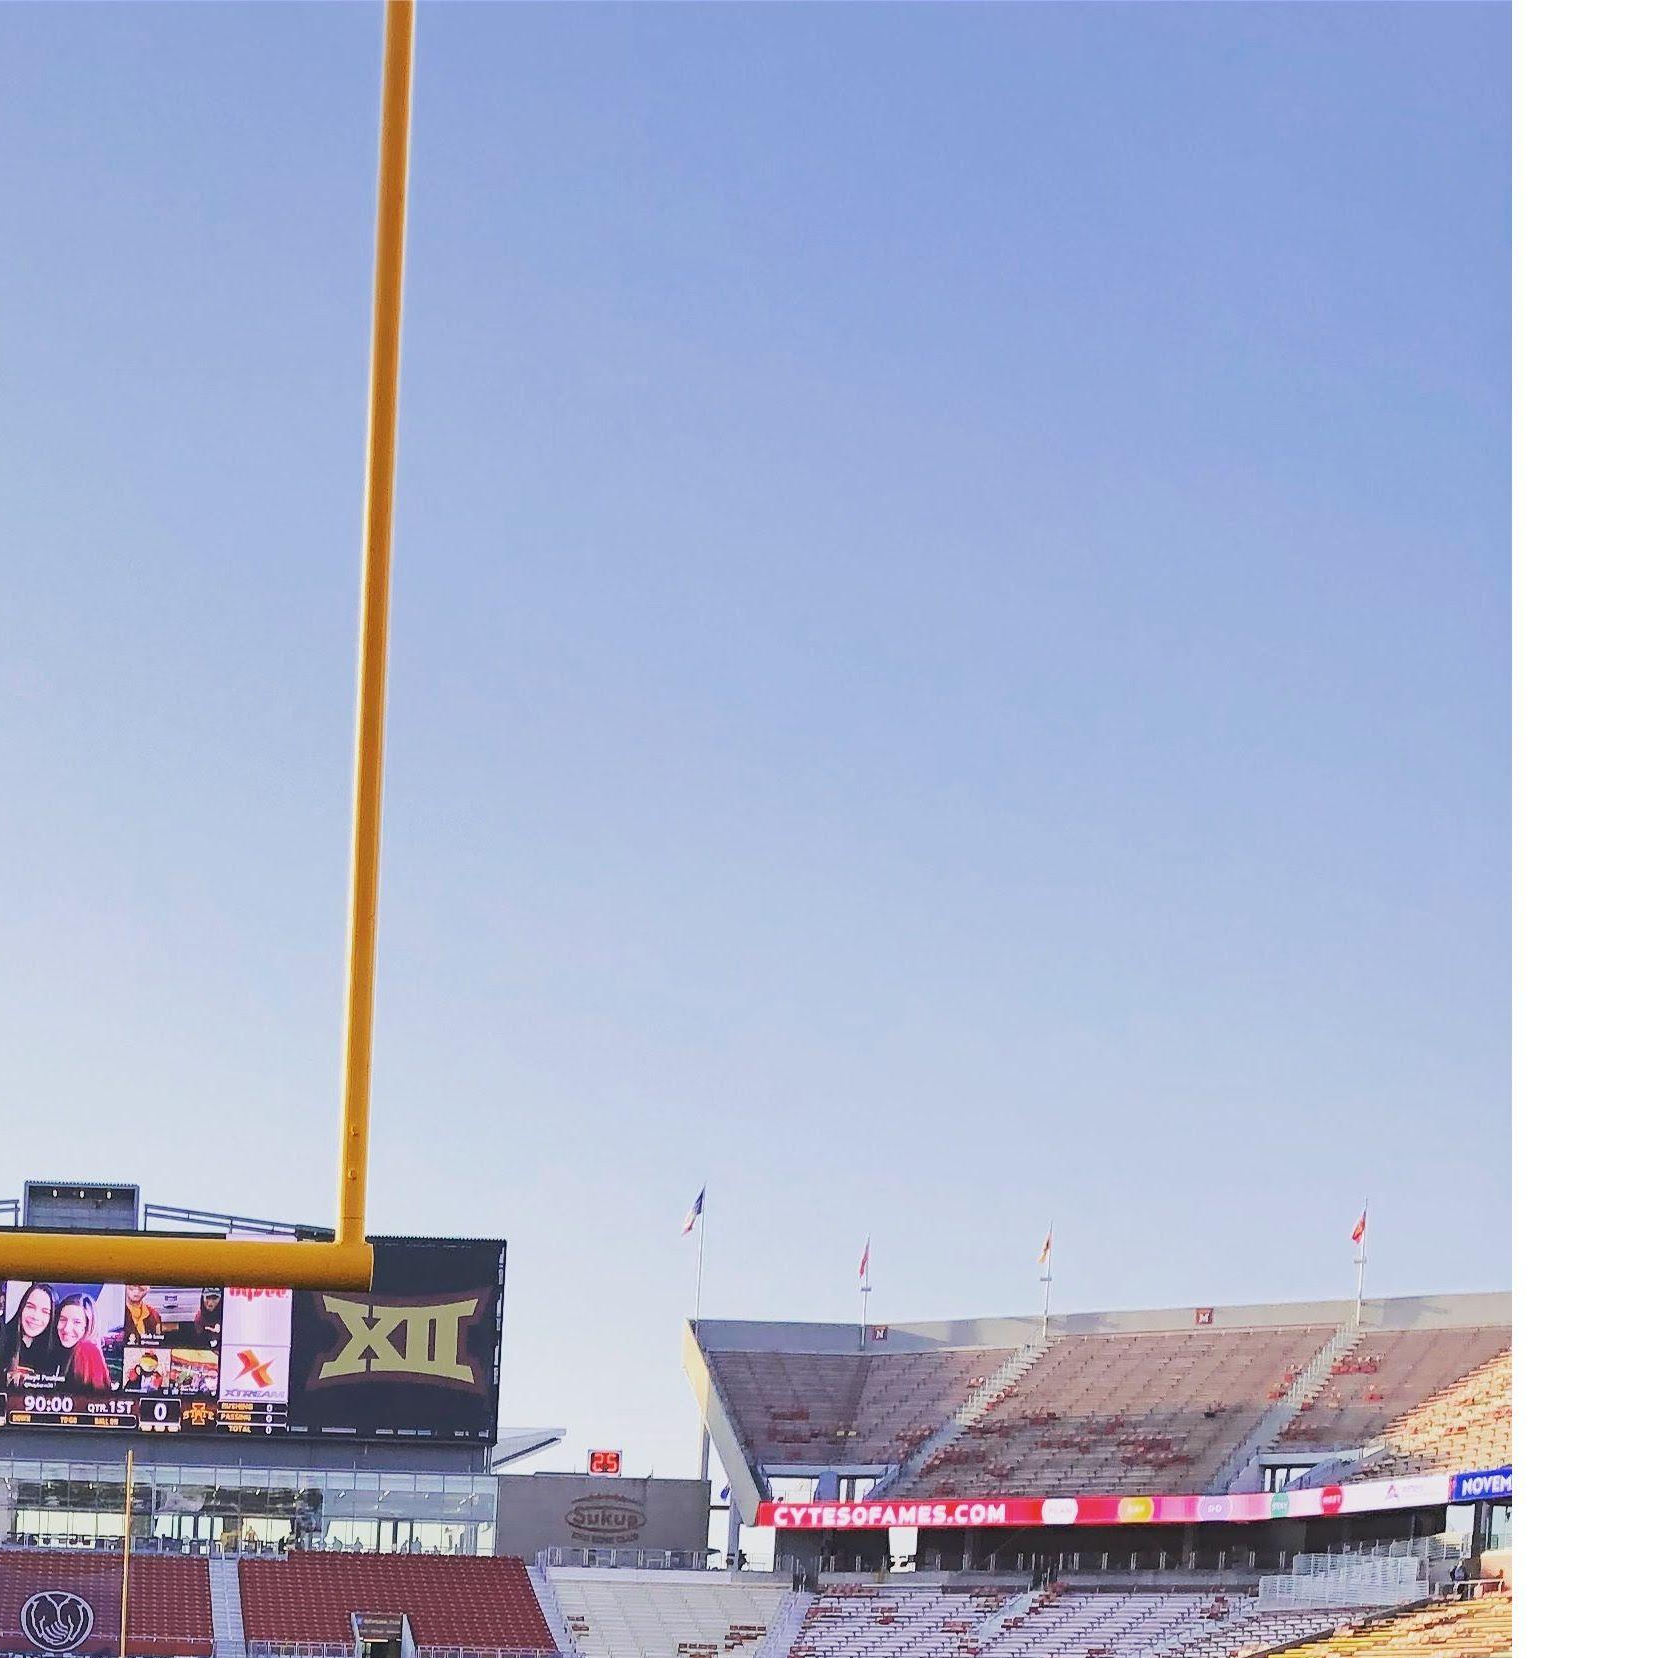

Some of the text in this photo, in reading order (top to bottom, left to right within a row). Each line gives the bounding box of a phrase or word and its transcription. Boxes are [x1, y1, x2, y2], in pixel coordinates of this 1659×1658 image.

[319, 1294, 479, 1385] XII
[24, 1396, 73, 1412] 90:00
[109, 1400, 134, 1414] 1ST
[153, 1403, 167, 1421] 0
[594, 1453, 619, 1473] 25
[572, 1506, 639, 1530] Sukup
[774, 1503, 1006, 1527] CYTESOFAMES.COM
